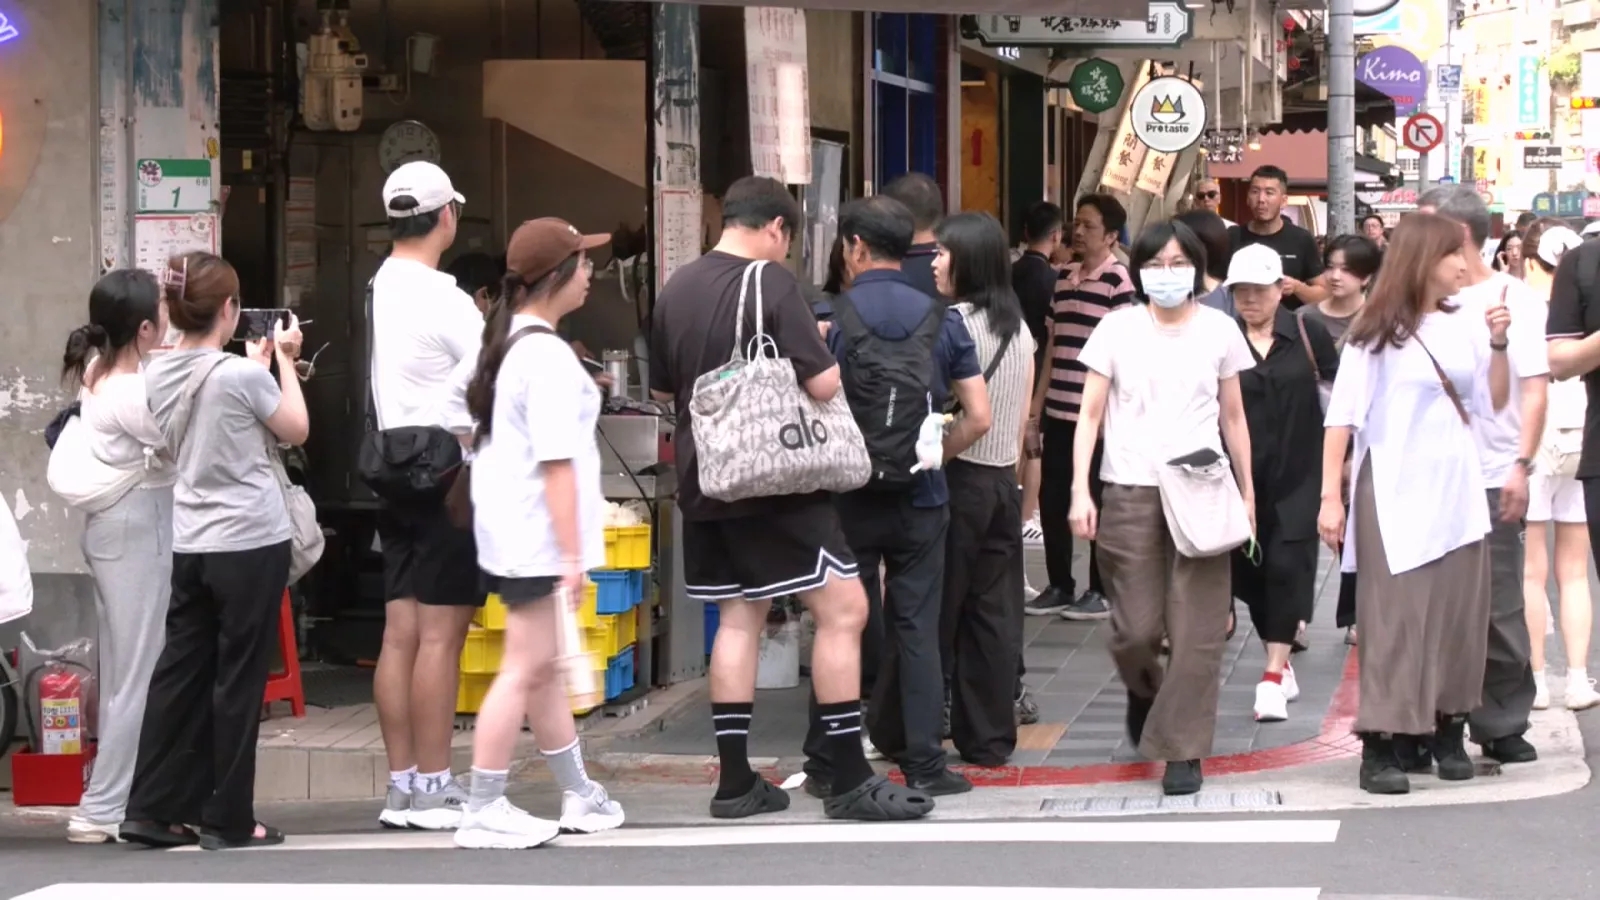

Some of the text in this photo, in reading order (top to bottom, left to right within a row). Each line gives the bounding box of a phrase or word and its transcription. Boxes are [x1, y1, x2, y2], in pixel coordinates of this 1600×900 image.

[1364, 57, 1420, 81] Kimo
[1146, 124, 1189, 133] Protaste
[171, 186, 181, 208] 1
[779, 406, 827, 450] alo
